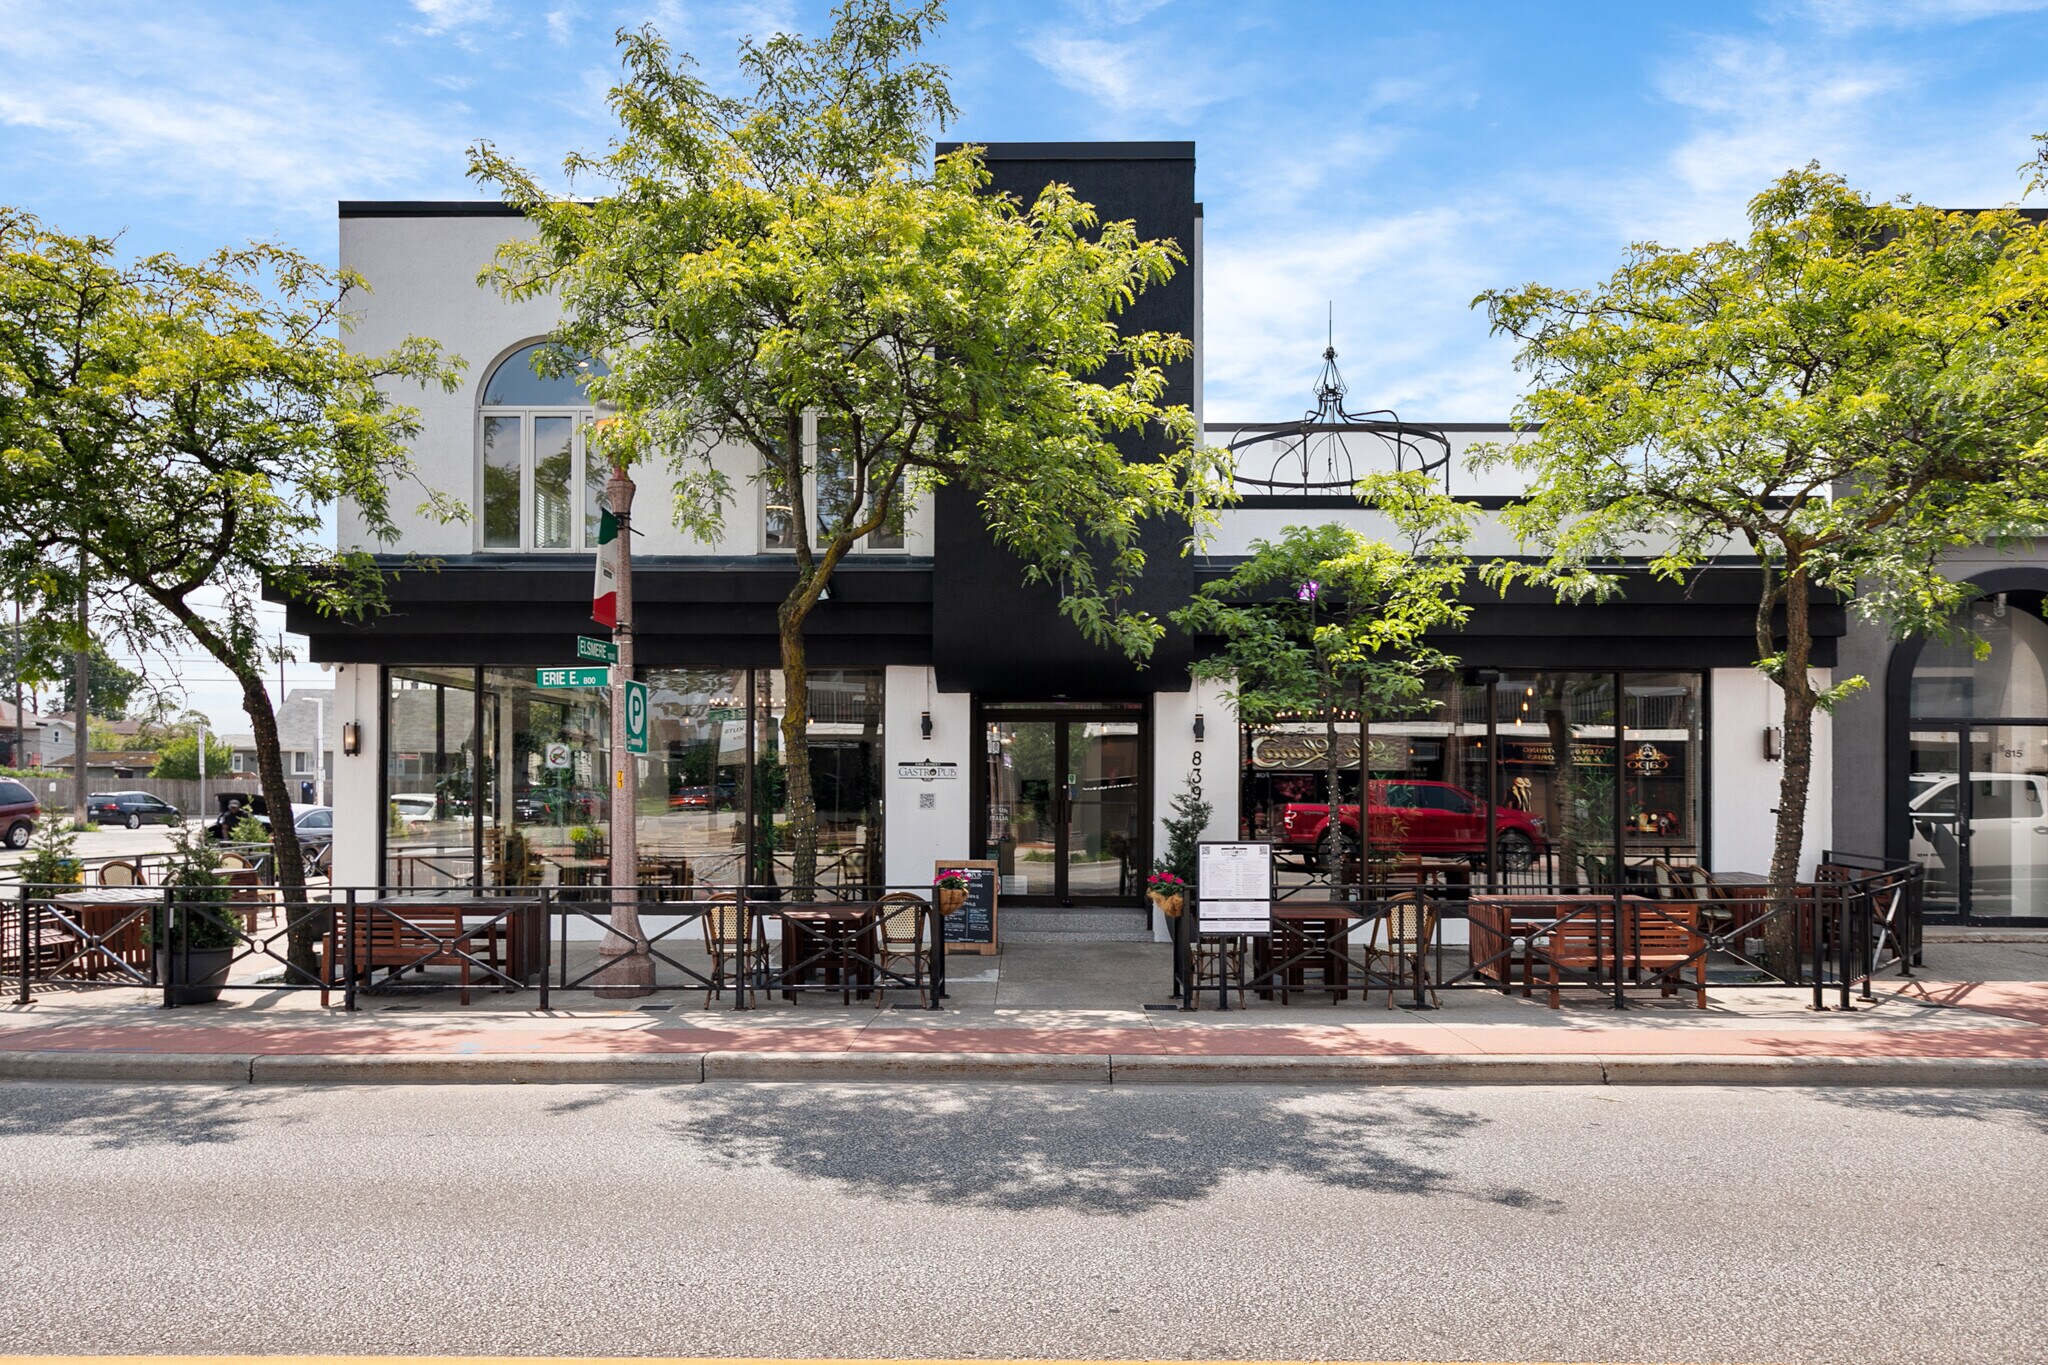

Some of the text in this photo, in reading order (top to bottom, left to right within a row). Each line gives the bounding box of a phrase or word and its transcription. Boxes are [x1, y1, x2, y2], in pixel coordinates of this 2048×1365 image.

[580, 640, 606, 658] ELSMERE
[542, 671, 596, 686] ERIE E. 800
[632, 695, 641, 727] P
[2004, 750, 2023, 758] 815
